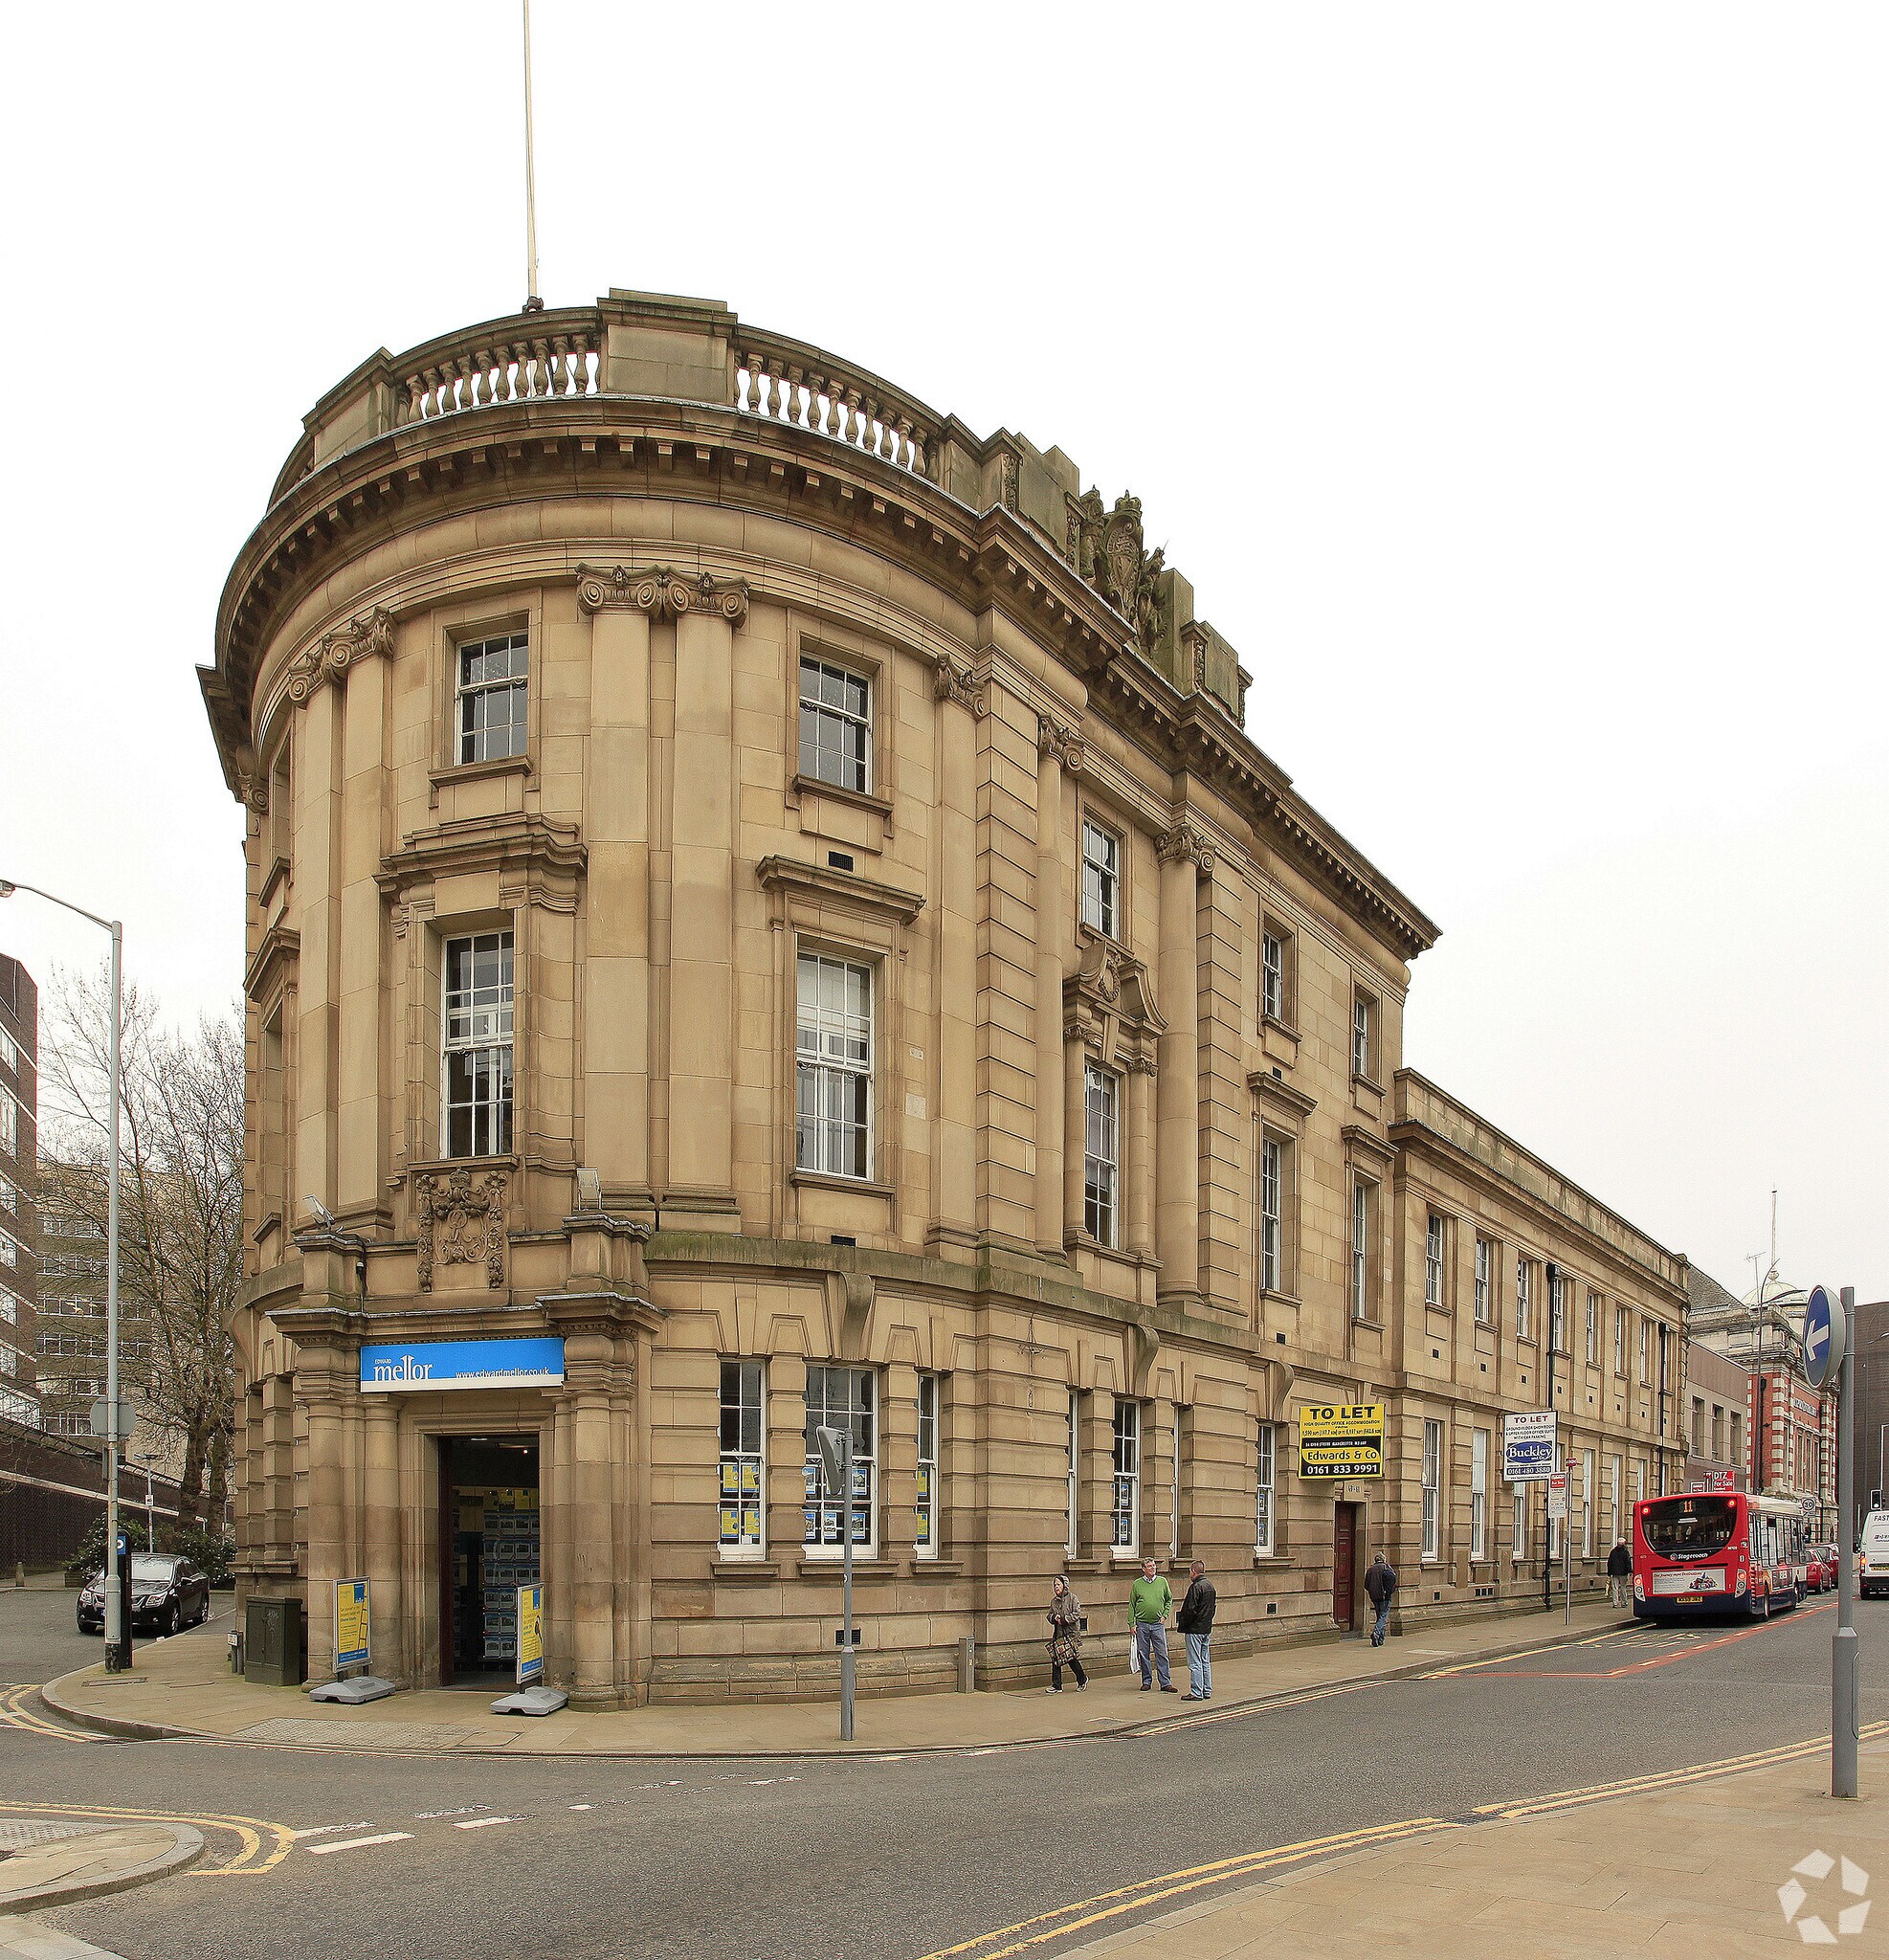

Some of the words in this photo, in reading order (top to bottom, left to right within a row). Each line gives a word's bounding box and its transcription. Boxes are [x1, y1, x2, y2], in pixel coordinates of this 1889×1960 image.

[373, 1354, 433, 1382] mellor
[455, 1367, 550, 1379] www.edwardmellor.co.uk
[1310, 1408, 1334, 1420] TO
[1341, 1406, 1375, 1419] LET
[1307, 1450, 1350, 1461] Edwards
[1354, 1451, 1362, 1459] &
[1365, 1450, 1377, 1459] Co
[1509, 1445, 1552, 1457] Buckley
[1307, 1465, 1329, 1474] 0161
[1333, 1465, 1350, 1473] 833
[1354, 1464, 1377, 1473] 9991
[1683, 1500, 1693, 1513] 11
